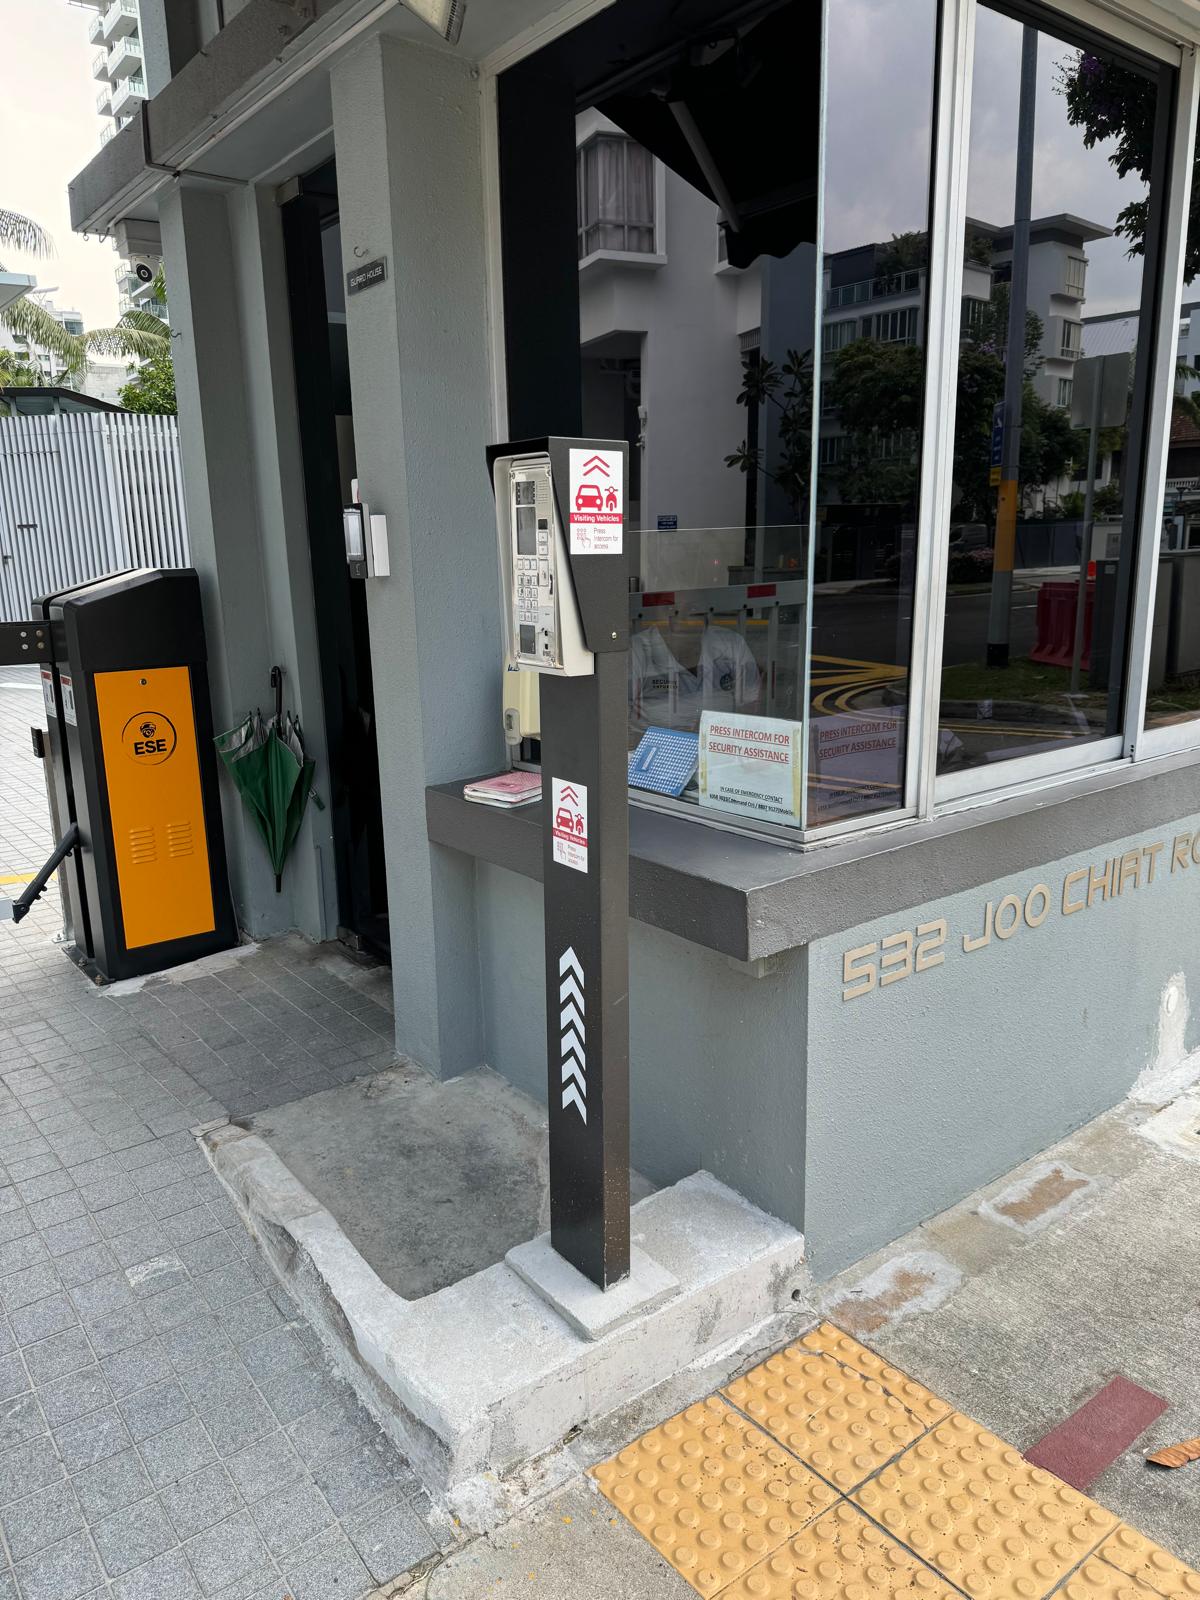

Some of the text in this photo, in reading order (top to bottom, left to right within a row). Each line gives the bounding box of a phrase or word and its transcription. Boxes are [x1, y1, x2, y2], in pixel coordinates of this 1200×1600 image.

[351, 266, 382, 286] GUARD HOUSE
[573, 514, 595, 522] Visiting
[710, 725, 790, 744] PRESS INTERCOM FOR
[820, 720, 897, 740] PRESS INTERCOM FOR
[134, 739, 167, 755] ESE
[709, 742, 790, 762] SECURITY ASSISTANCE
[819, 737, 897, 758] SECURITY ASSISTANCE
[765, 794, 783, 803] CONTACT
[842, 918, 947, 1001] 532
[963, 883, 1051, 953] JOO
[1062, 842, 1164, 915] CHIAT
